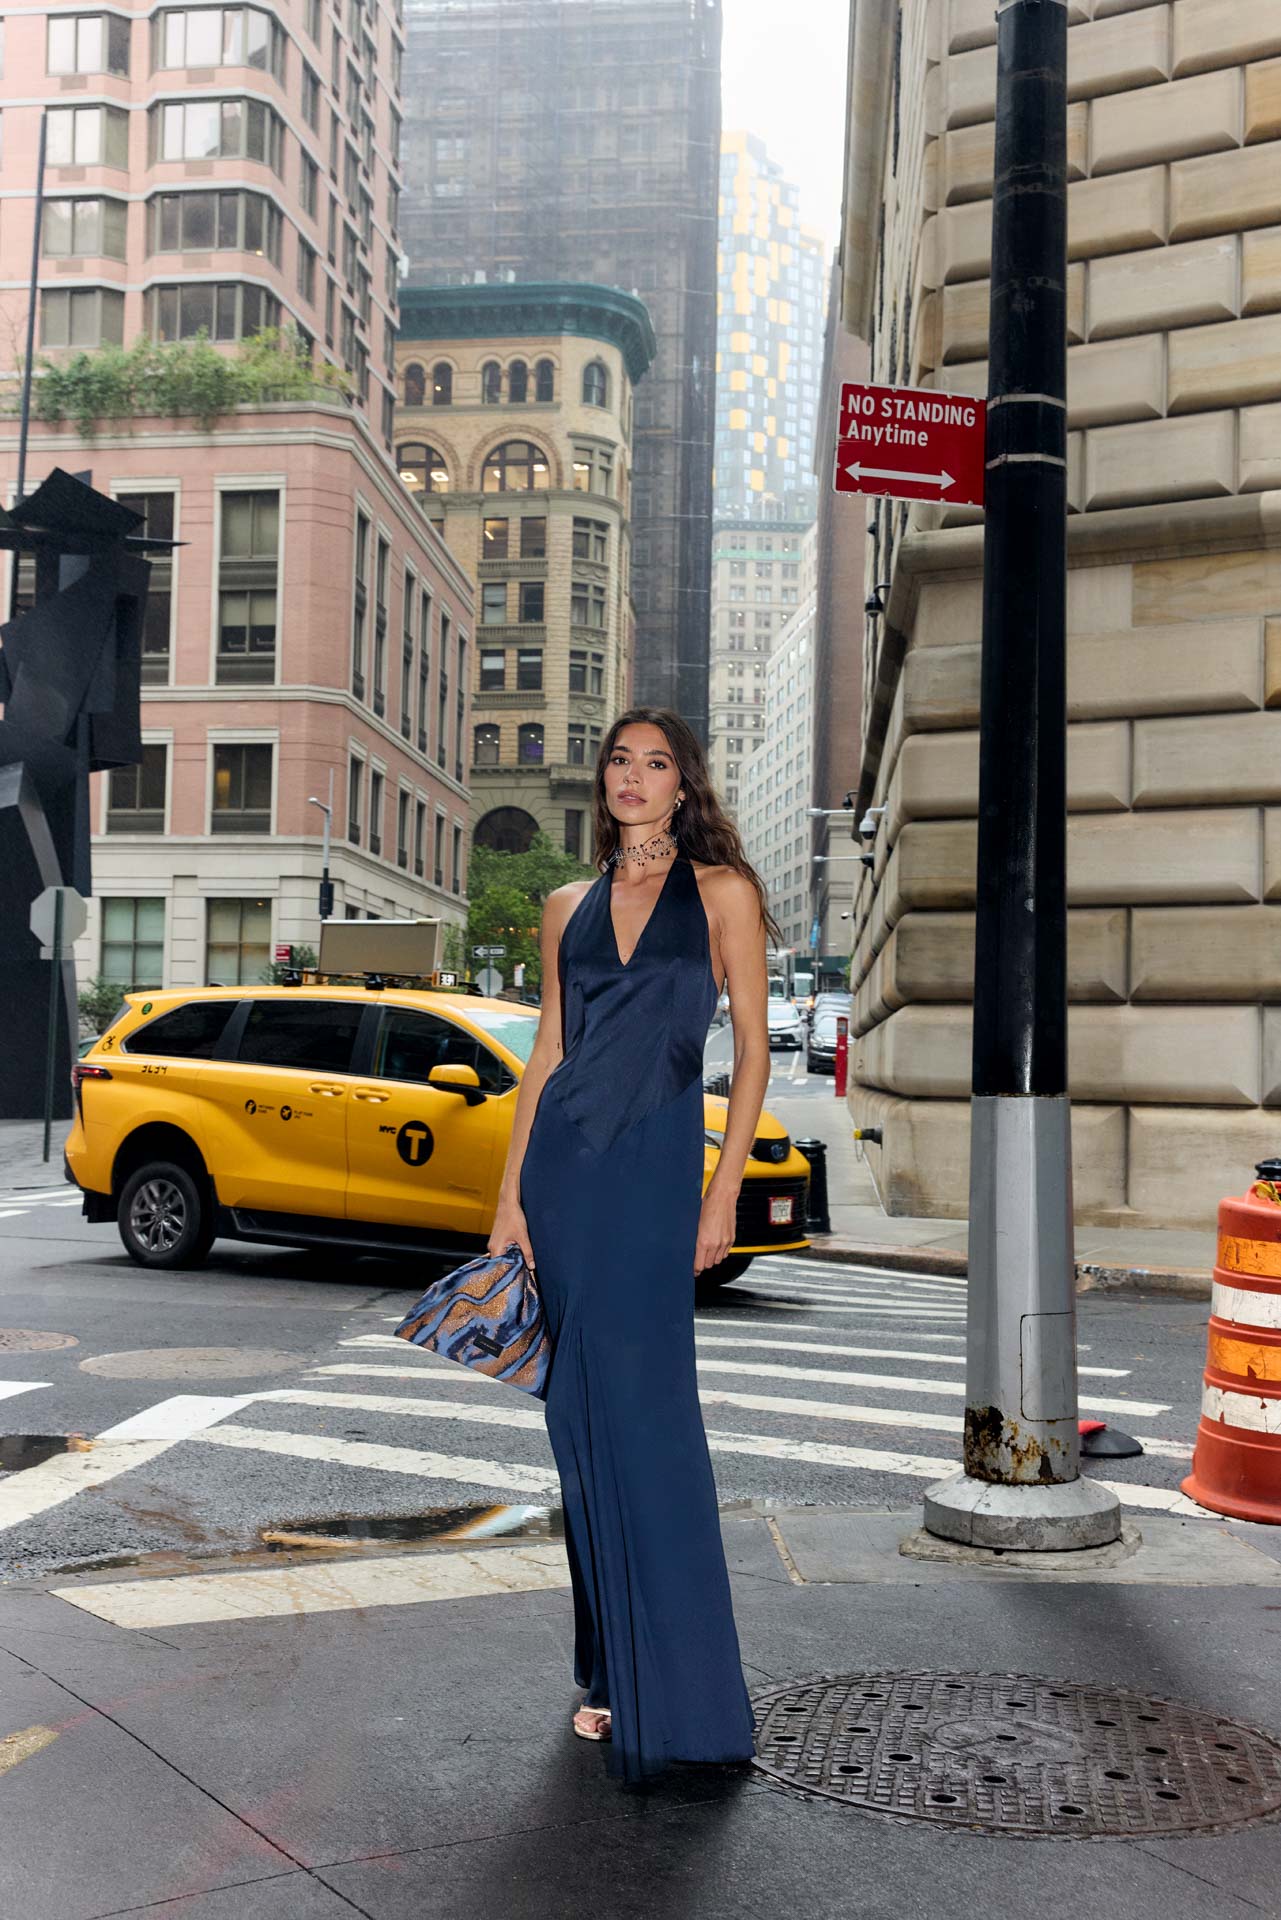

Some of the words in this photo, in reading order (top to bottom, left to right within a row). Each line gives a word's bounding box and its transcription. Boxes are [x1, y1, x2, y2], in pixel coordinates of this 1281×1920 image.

[848, 394, 875, 416] NO
[881, 397, 976, 427] STANDING
[847, 419, 929, 446] Anytime
[379, 1125, 397, 1135] NYC
[405, 1128, 427, 1161] T
